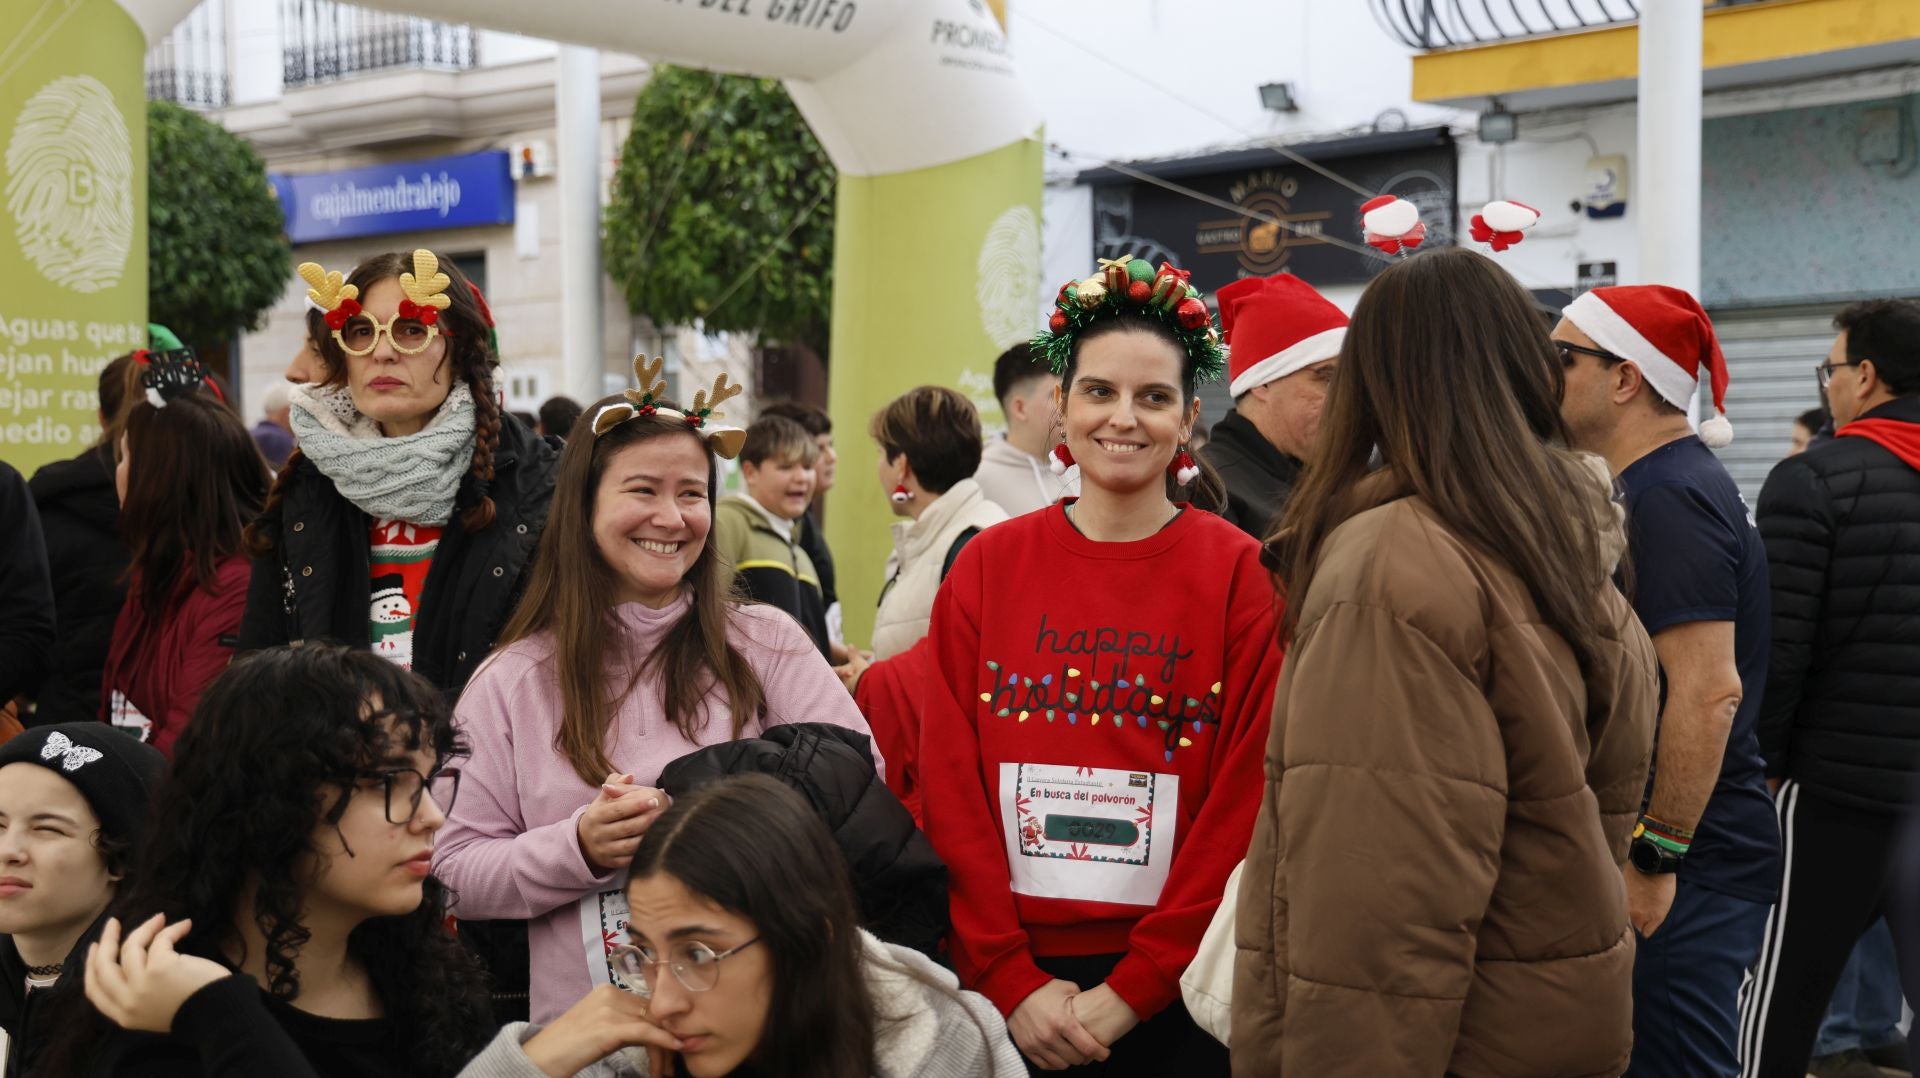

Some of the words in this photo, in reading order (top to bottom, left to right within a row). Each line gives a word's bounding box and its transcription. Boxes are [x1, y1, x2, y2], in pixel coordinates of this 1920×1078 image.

[766, 0, 857, 33] GRIFO
[311, 170, 461, 227] cajalmendralejo
[85, 321, 126, 350] que
[61, 389, 101, 411] ras
[0, 416, 73, 444] edio
[1035, 613, 1195, 684] happy
[990, 663, 1220, 752] holidays
[1030, 787, 1042, 798] En
[1044, 788, 1071, 800] busca
[1073, 789, 1089, 801] del
[1091, 792, 1136, 806] polvorón
[616, 920, 628, 930] En
